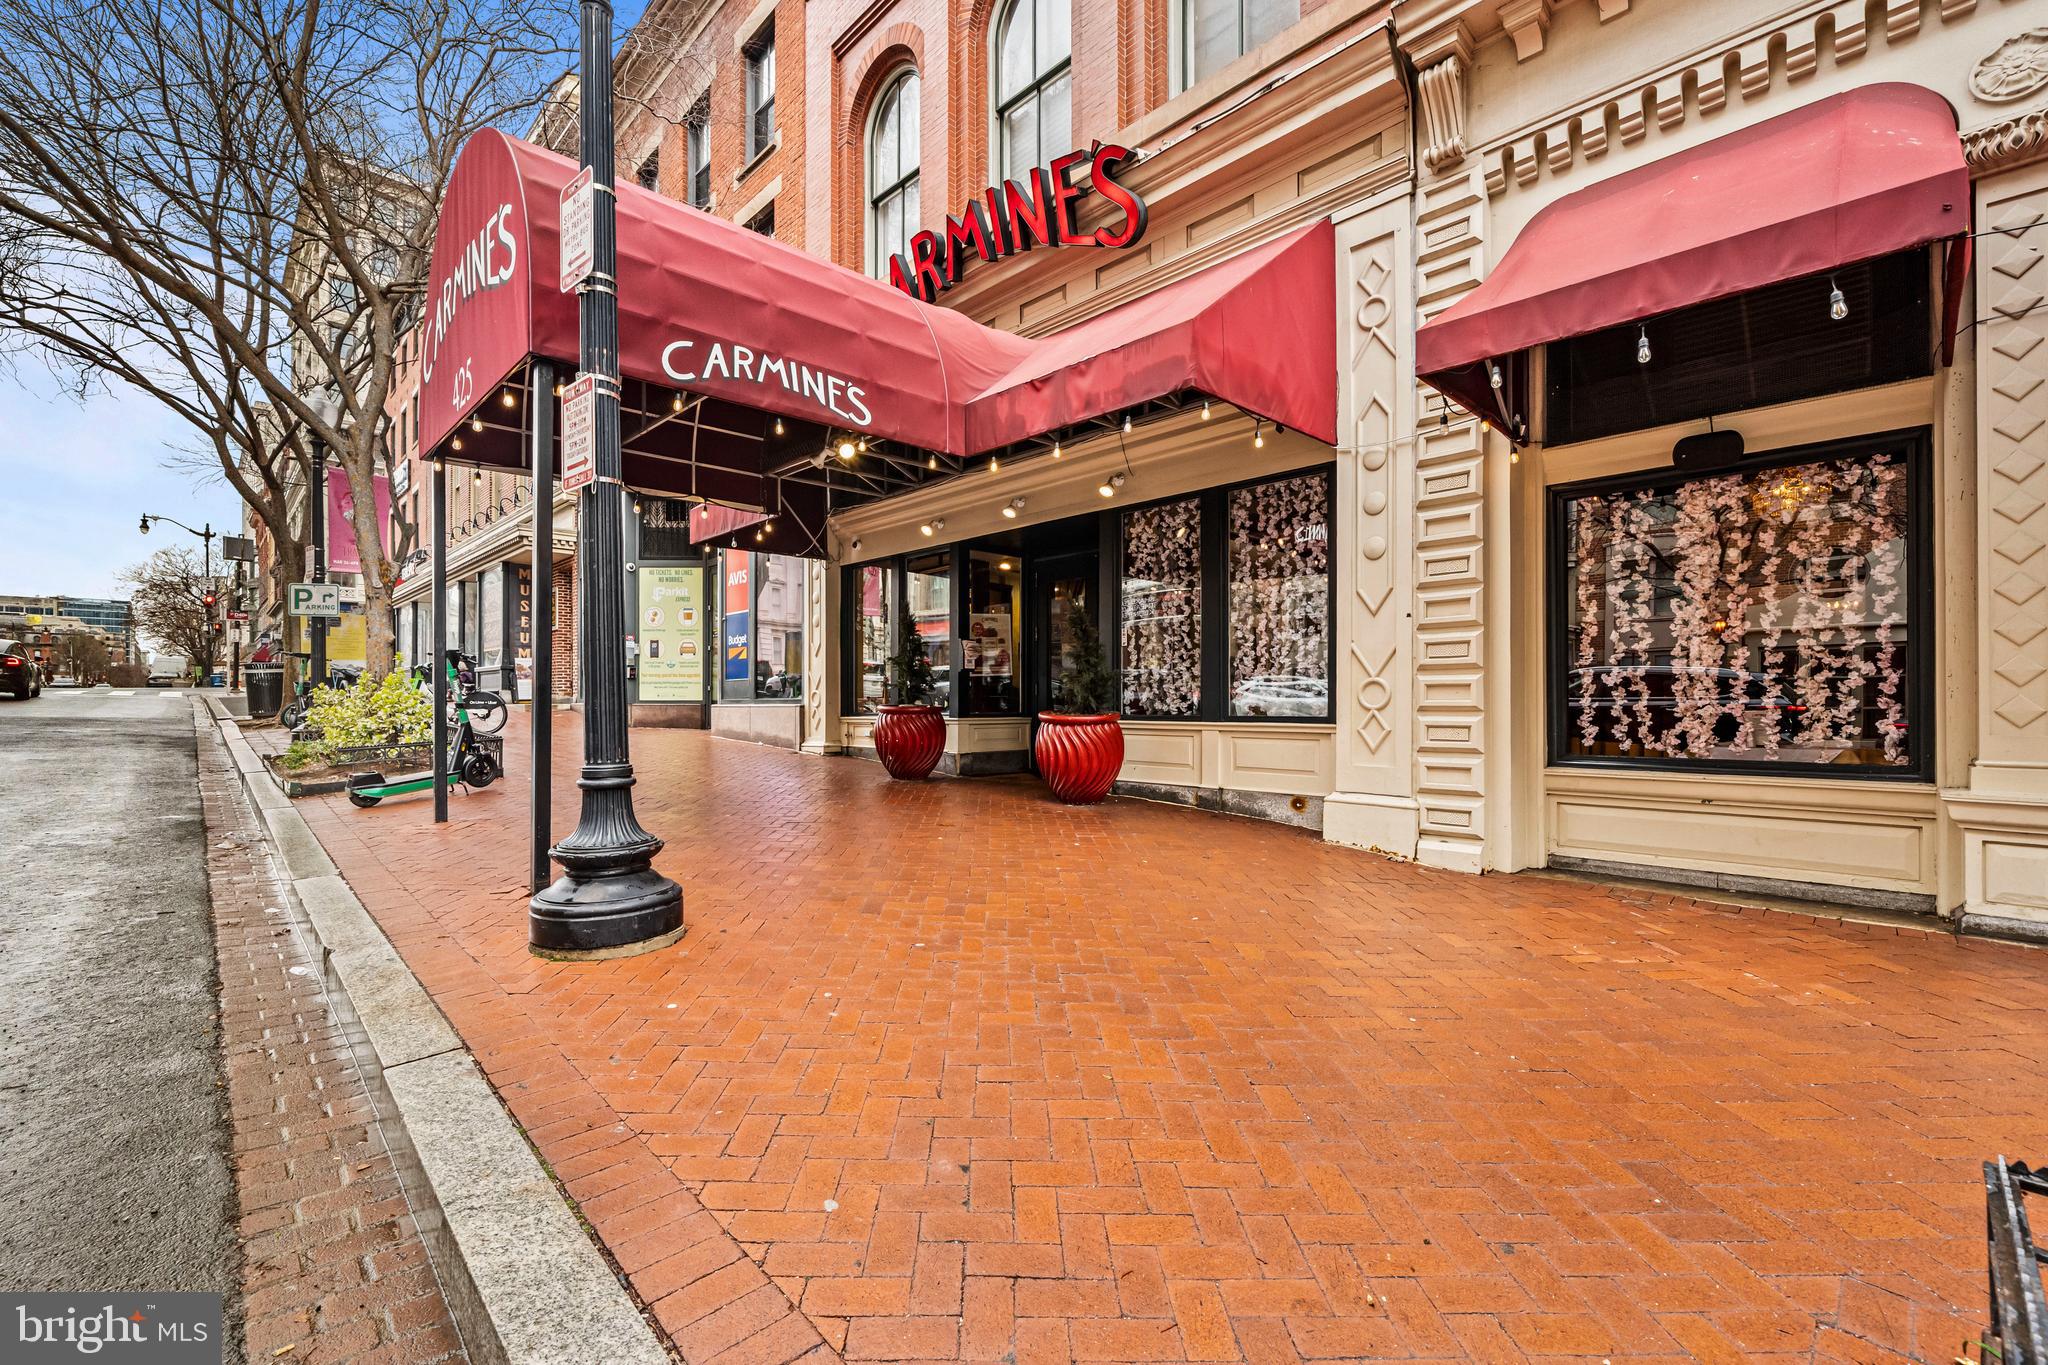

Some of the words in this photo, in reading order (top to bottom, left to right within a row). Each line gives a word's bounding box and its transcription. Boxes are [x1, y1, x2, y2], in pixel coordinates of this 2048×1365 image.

[889, 139, 1148, 301] ARMINE'S
[423, 203, 516, 385] CARMINE'S
[452, 357, 472, 412] 425
[661, 340, 872, 426] CARMINE'S
[518, 568, 531, 658] MUSEUM
[728, 569, 747, 587] AVIS
[728, 634, 747, 646] Budget
